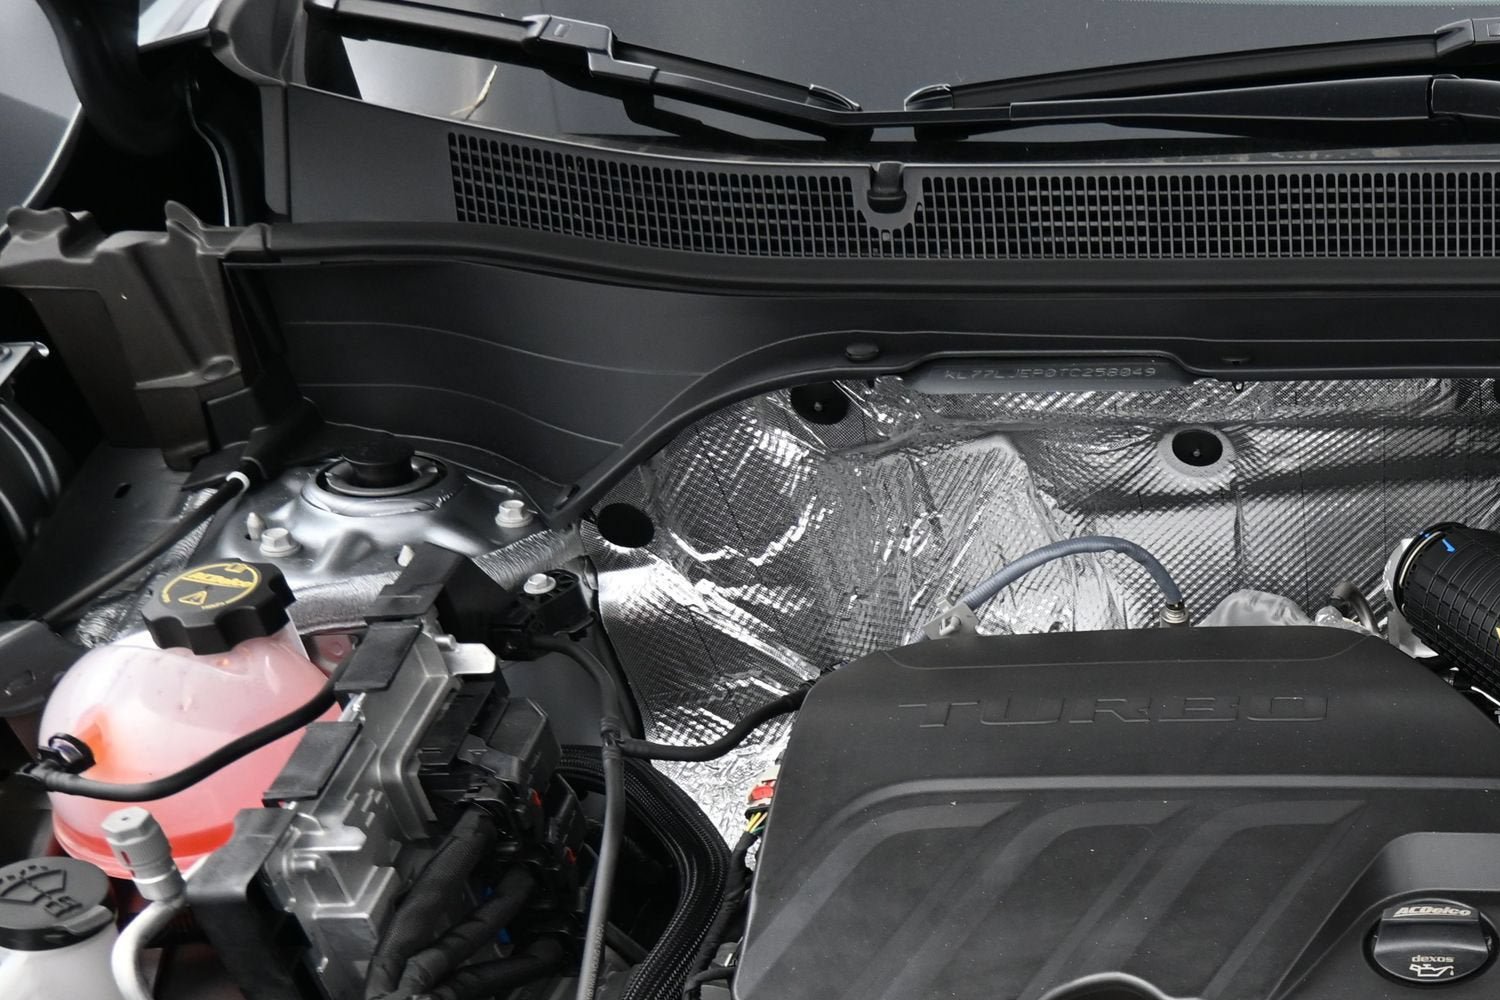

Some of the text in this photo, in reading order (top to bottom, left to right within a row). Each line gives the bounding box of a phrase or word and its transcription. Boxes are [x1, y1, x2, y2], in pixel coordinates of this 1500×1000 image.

[898, 696, 1329, 728] TURBO
[1393, 906, 1472, 917] ACDelco
[1411, 954, 1456, 963] dexos
